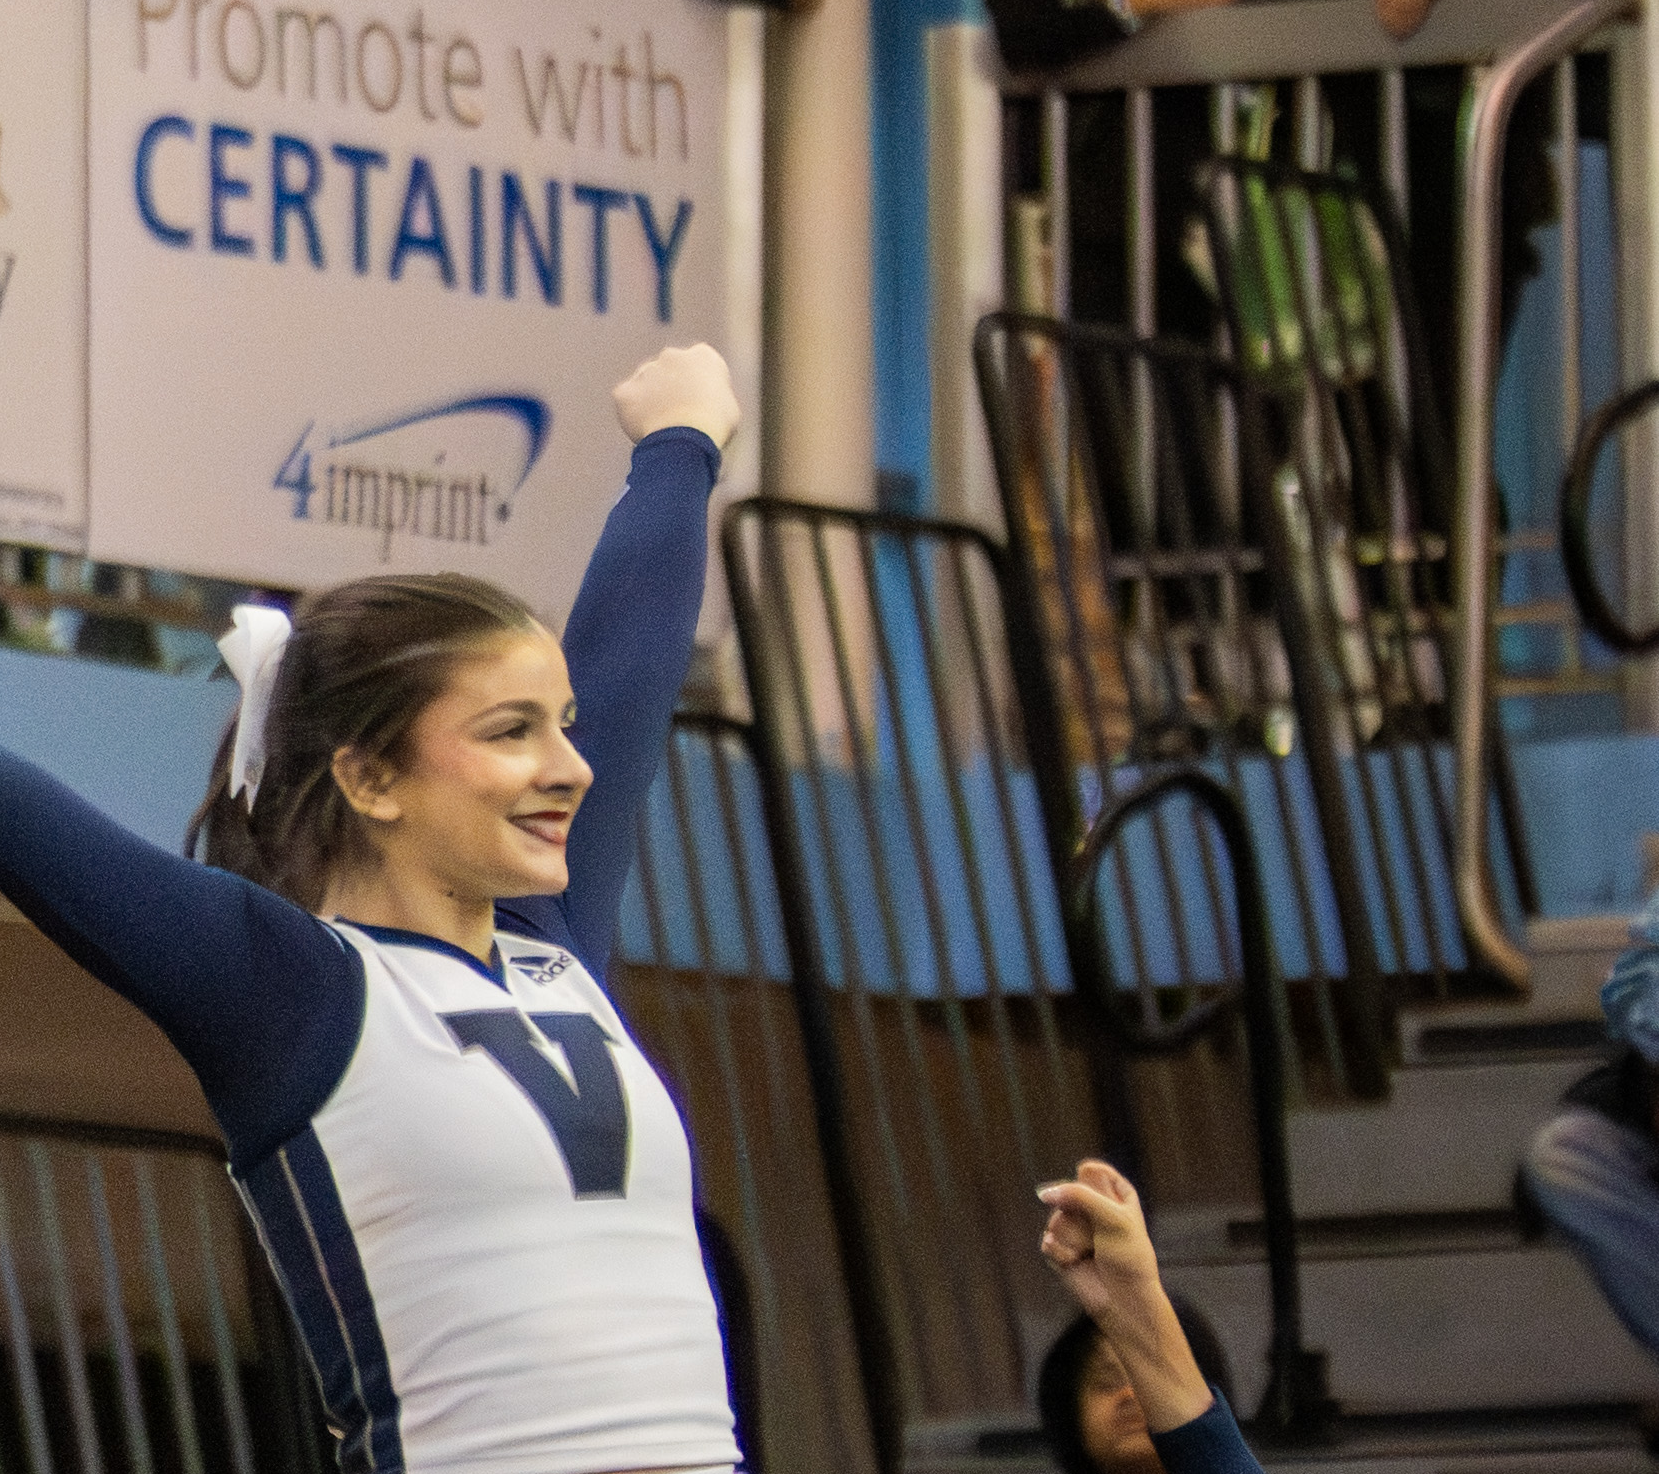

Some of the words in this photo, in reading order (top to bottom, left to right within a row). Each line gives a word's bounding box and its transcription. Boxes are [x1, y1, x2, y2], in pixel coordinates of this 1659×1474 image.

[513, 27, 692, 162] with
[132, 113, 696, 325] CERTAINTY
[272, 421, 495, 564] 4imprint
[434, 1006, 633, 1201] V
